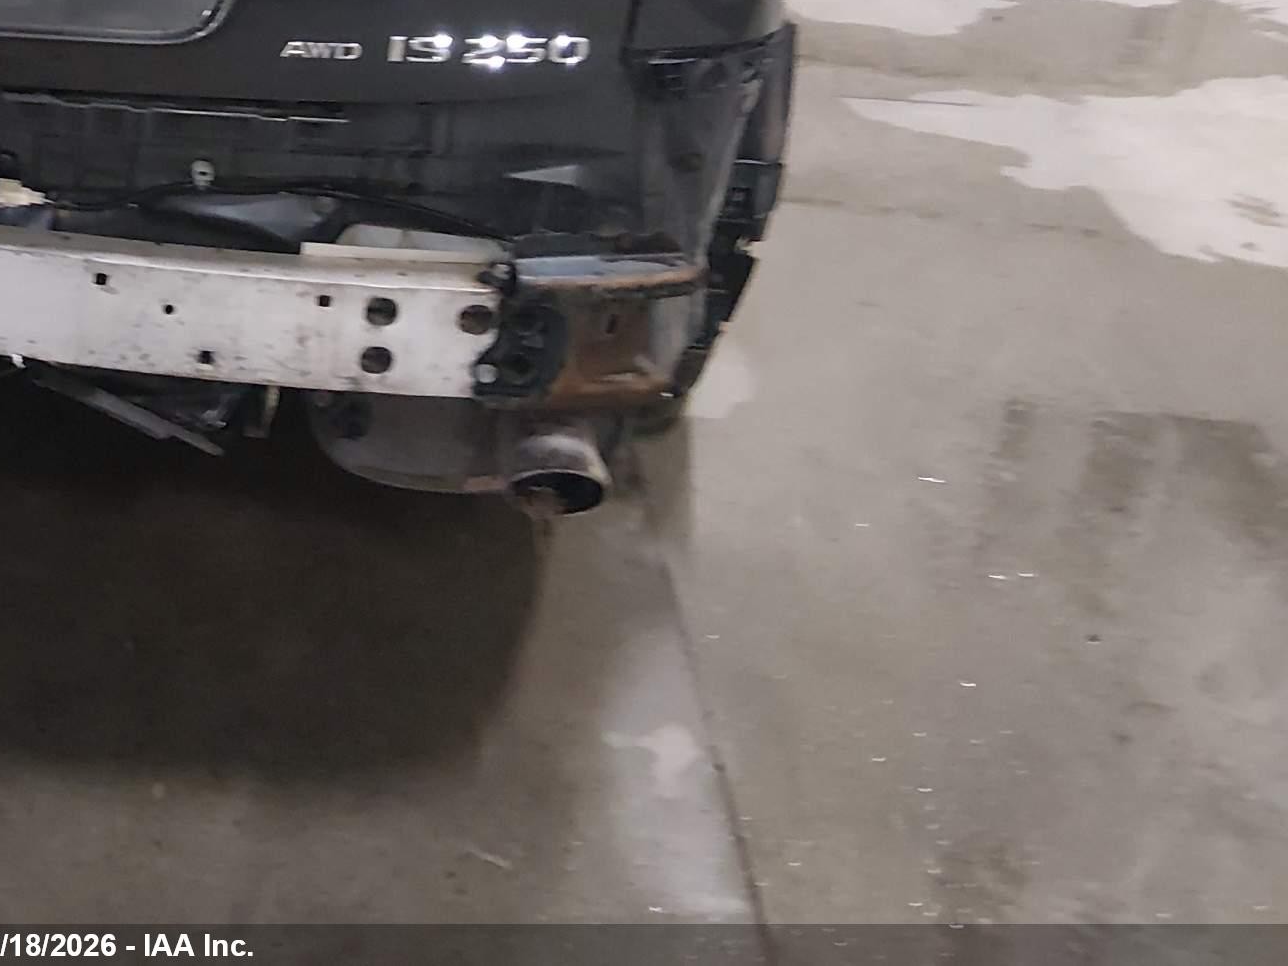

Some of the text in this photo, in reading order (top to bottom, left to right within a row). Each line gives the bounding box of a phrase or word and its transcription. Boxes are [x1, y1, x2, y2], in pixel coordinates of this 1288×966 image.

[279, 34, 592, 67] AWD IS 250
